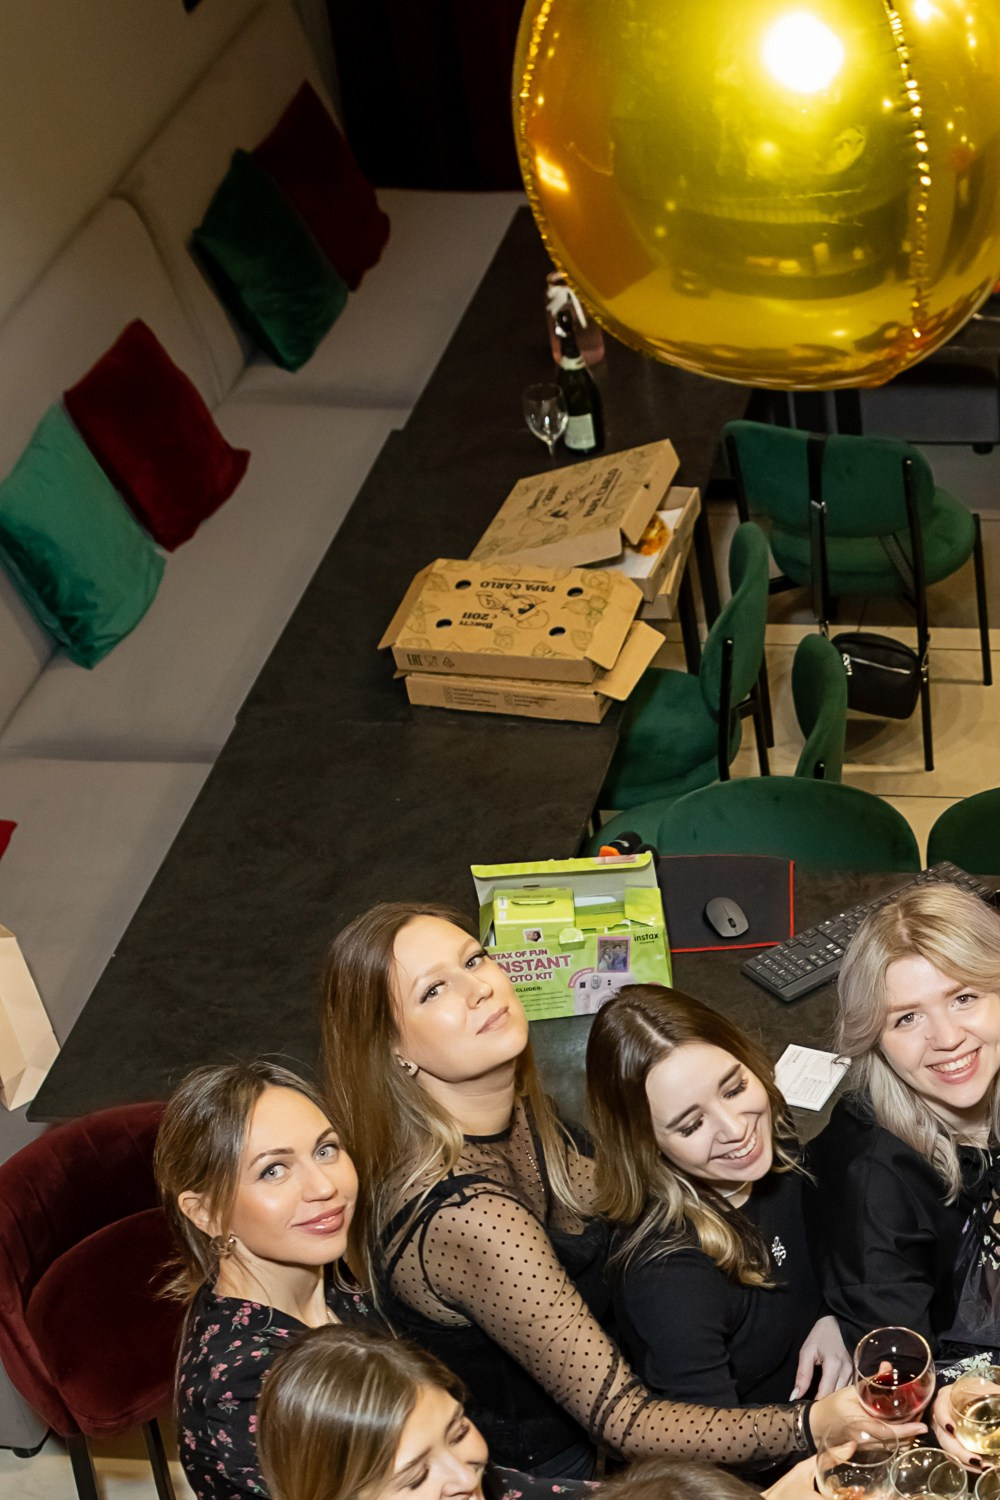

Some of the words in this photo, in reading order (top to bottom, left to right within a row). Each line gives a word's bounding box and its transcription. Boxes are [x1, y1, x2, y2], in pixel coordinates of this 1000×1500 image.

[480, 580, 522, 590] CARLO
[525, 584, 556, 593] PAPA
[633, 932, 659, 942] instax
[490, 952, 513, 961] STAX
[514, 950, 527, 958] OF
[529, 949, 548, 957] FUN
[497, 955, 571, 974] NSTANT
[509, 973, 533, 983] OTO
[535, 971, 553, 980] KIT
